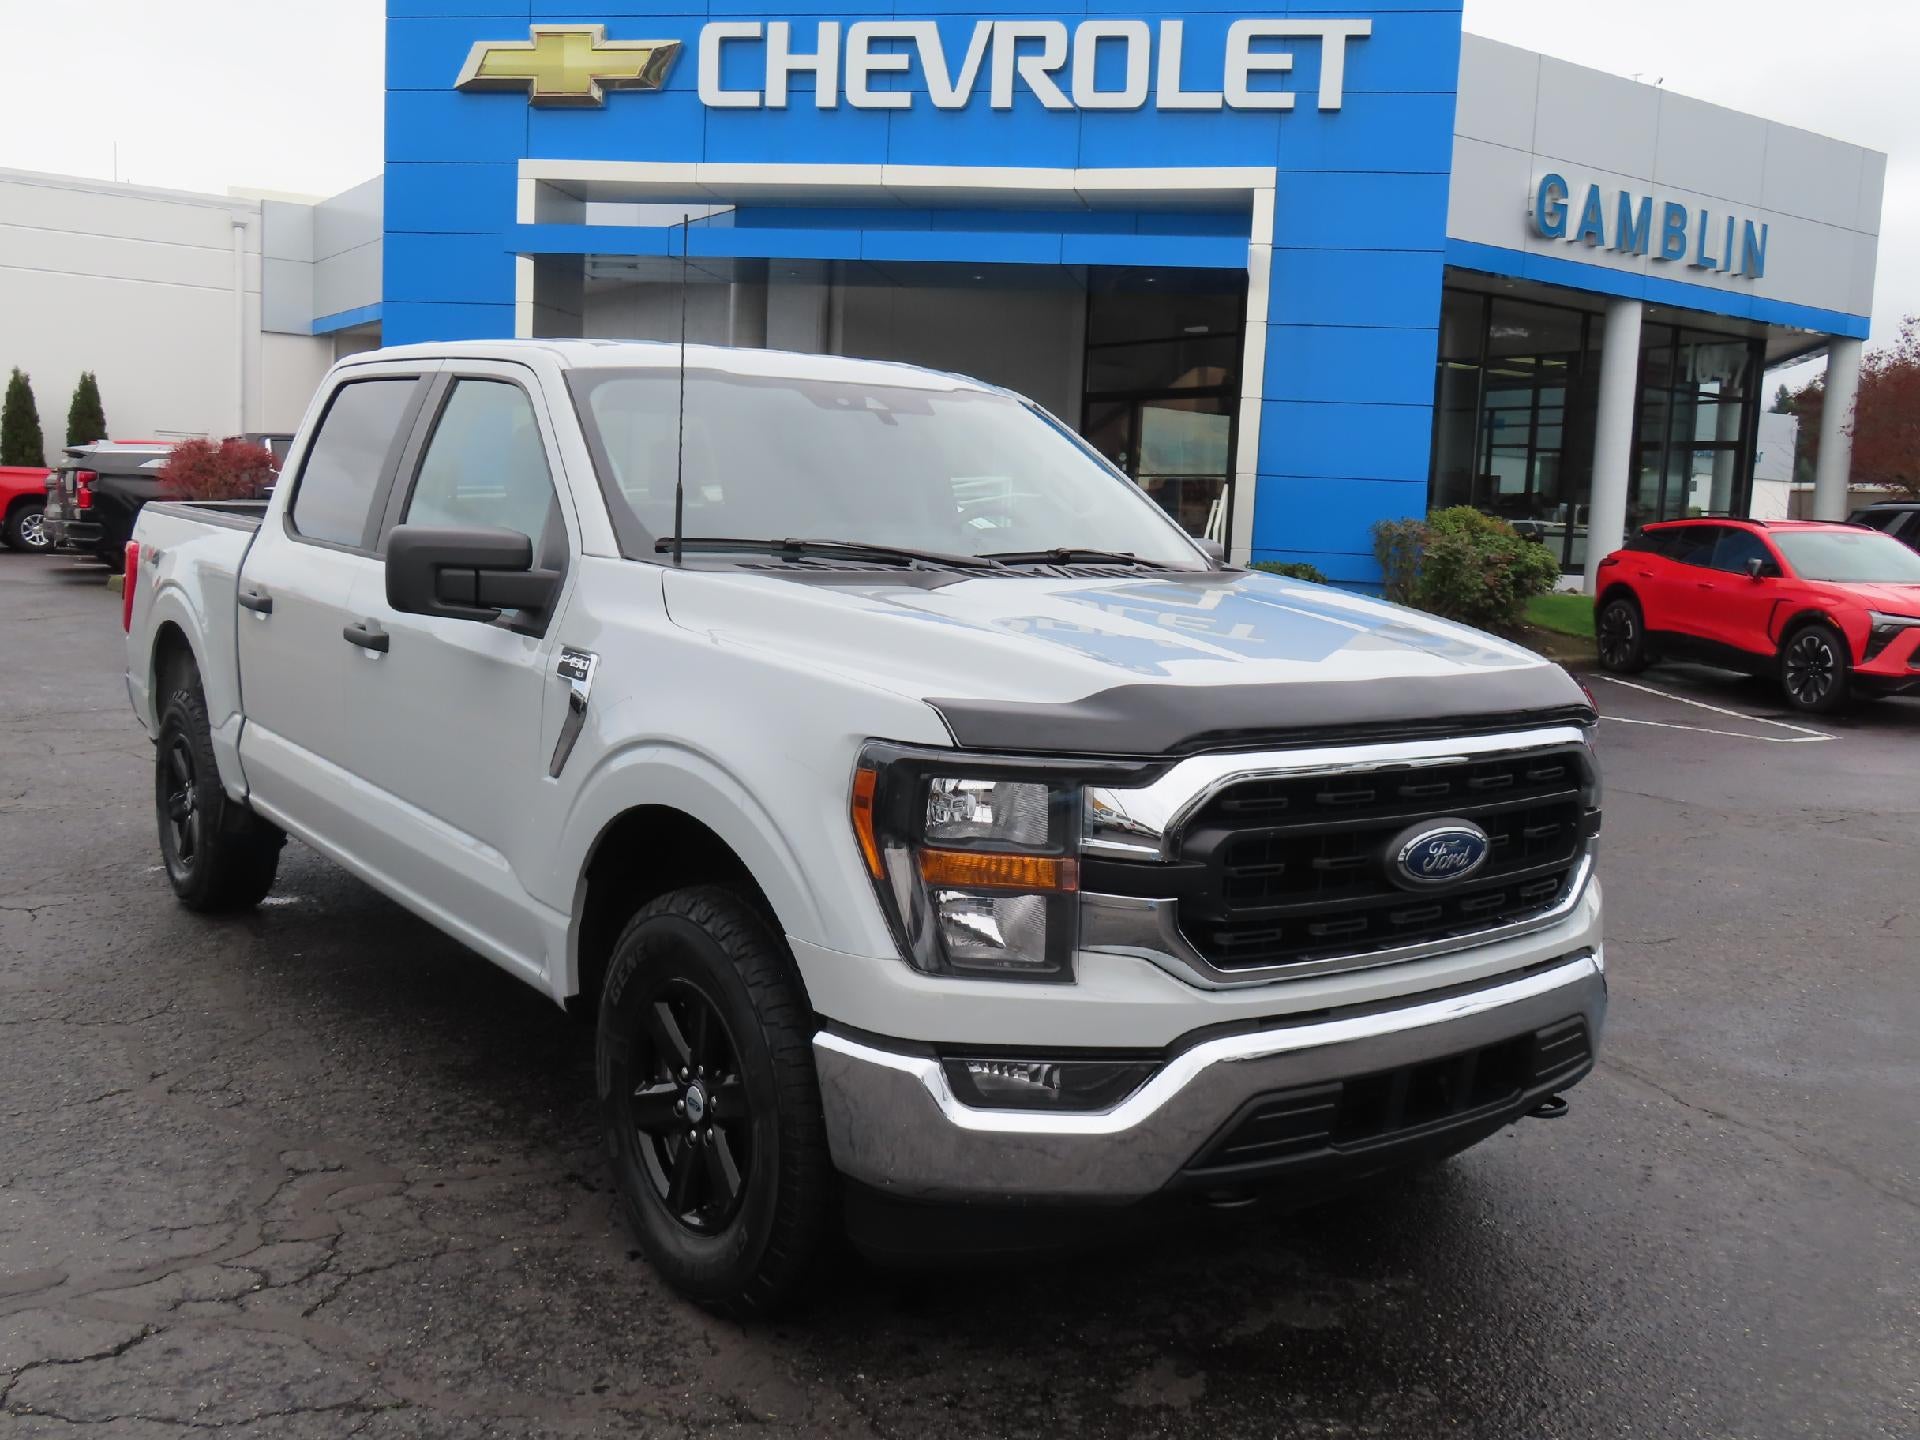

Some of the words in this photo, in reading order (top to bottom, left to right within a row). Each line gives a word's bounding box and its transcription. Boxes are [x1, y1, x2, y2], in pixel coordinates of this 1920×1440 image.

[698, 19, 1372, 112] CHEVROLET
[1534, 172, 1769, 279] GAMBLIN
[1422, 839, 1471, 873] Ford
